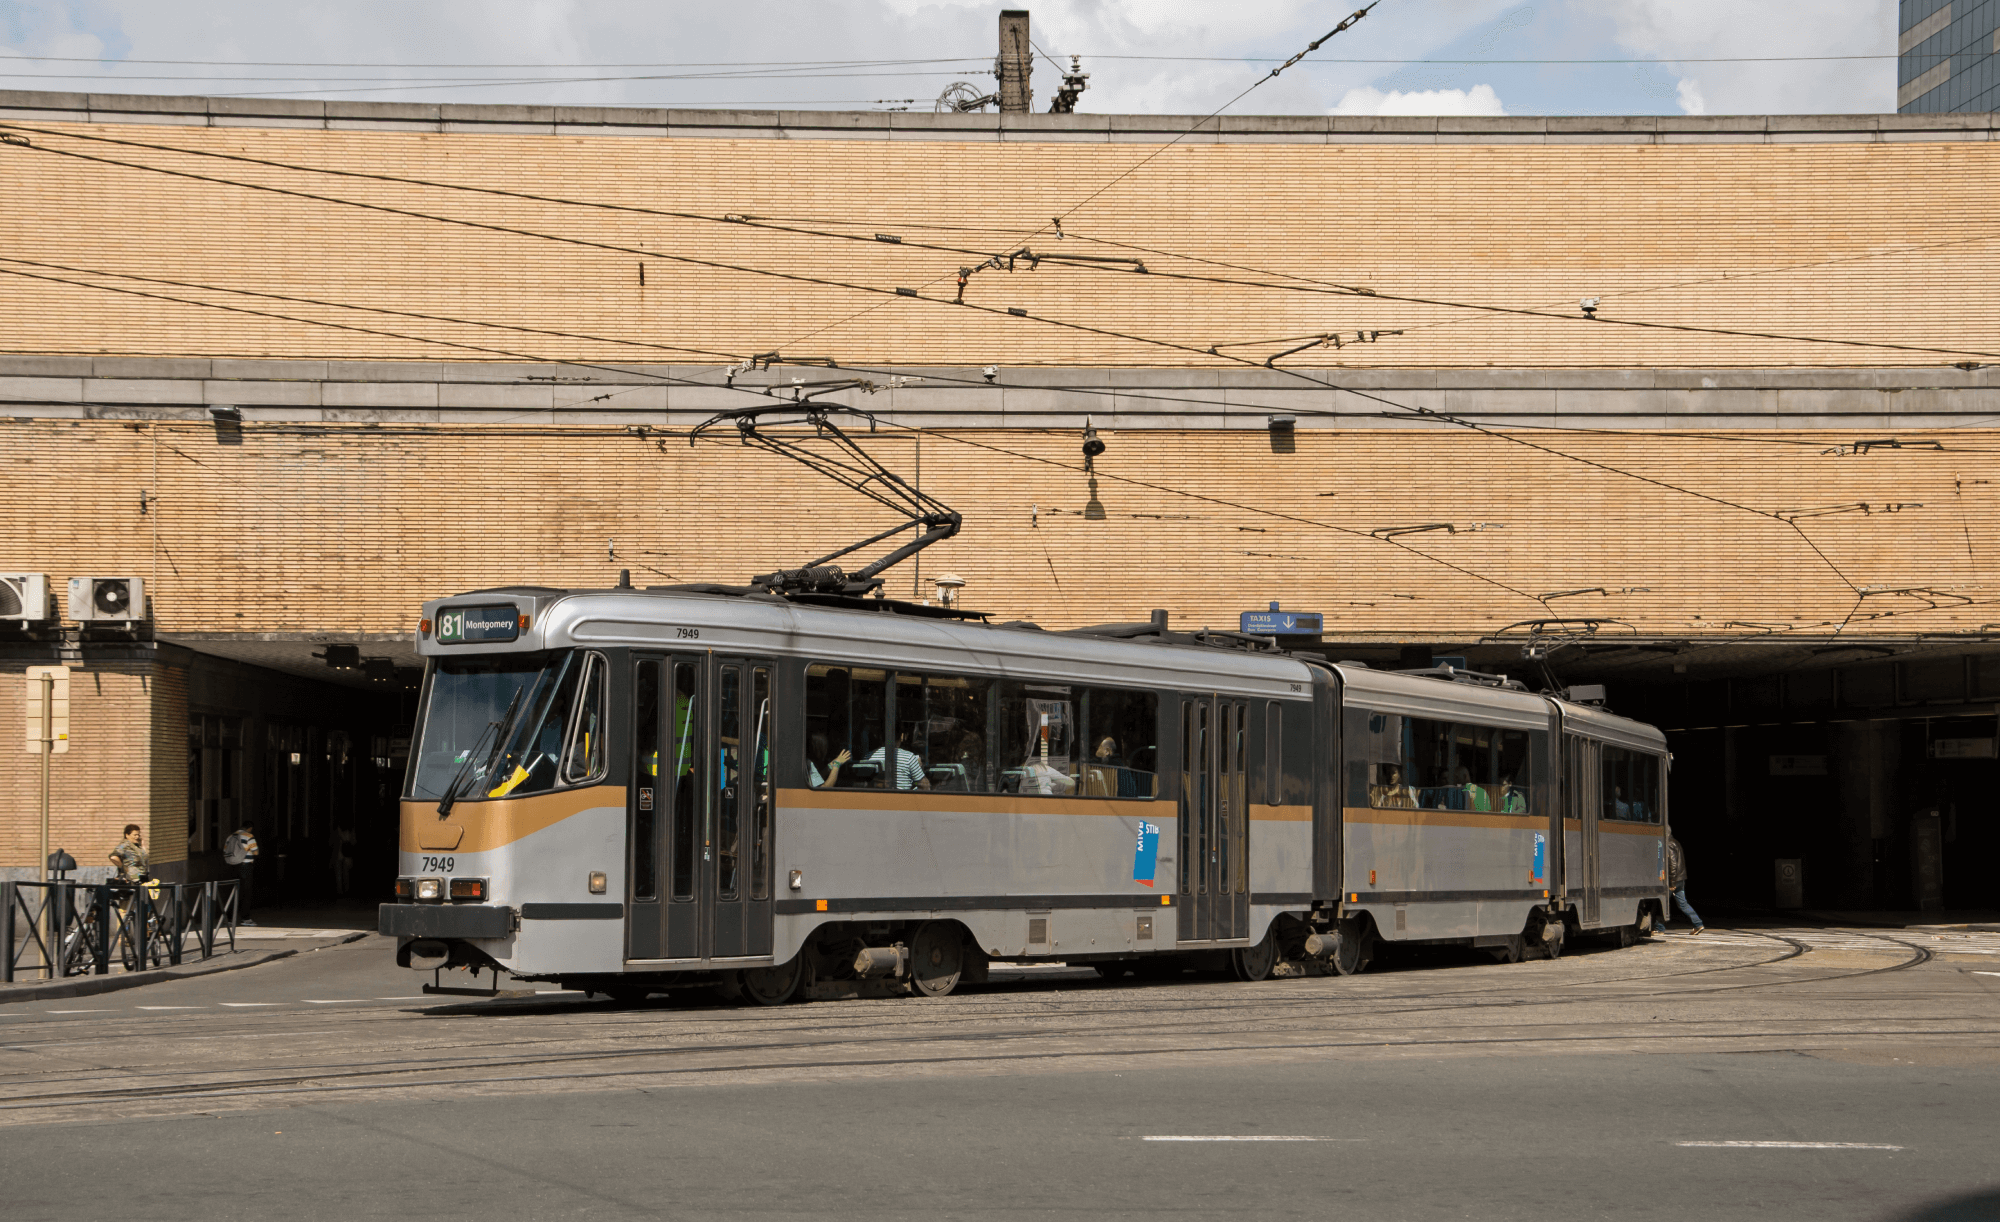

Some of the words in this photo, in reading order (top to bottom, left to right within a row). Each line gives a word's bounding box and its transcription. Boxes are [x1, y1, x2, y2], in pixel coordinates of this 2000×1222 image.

[443, 615, 461, 636] 81
[465, 620, 513, 631] Montgomery
[677, 628, 699, 639] 7949
[1290, 683, 1302, 692] 7949
[1145, 824, 1159, 834] STIB
[422, 856, 455, 872] 7949
